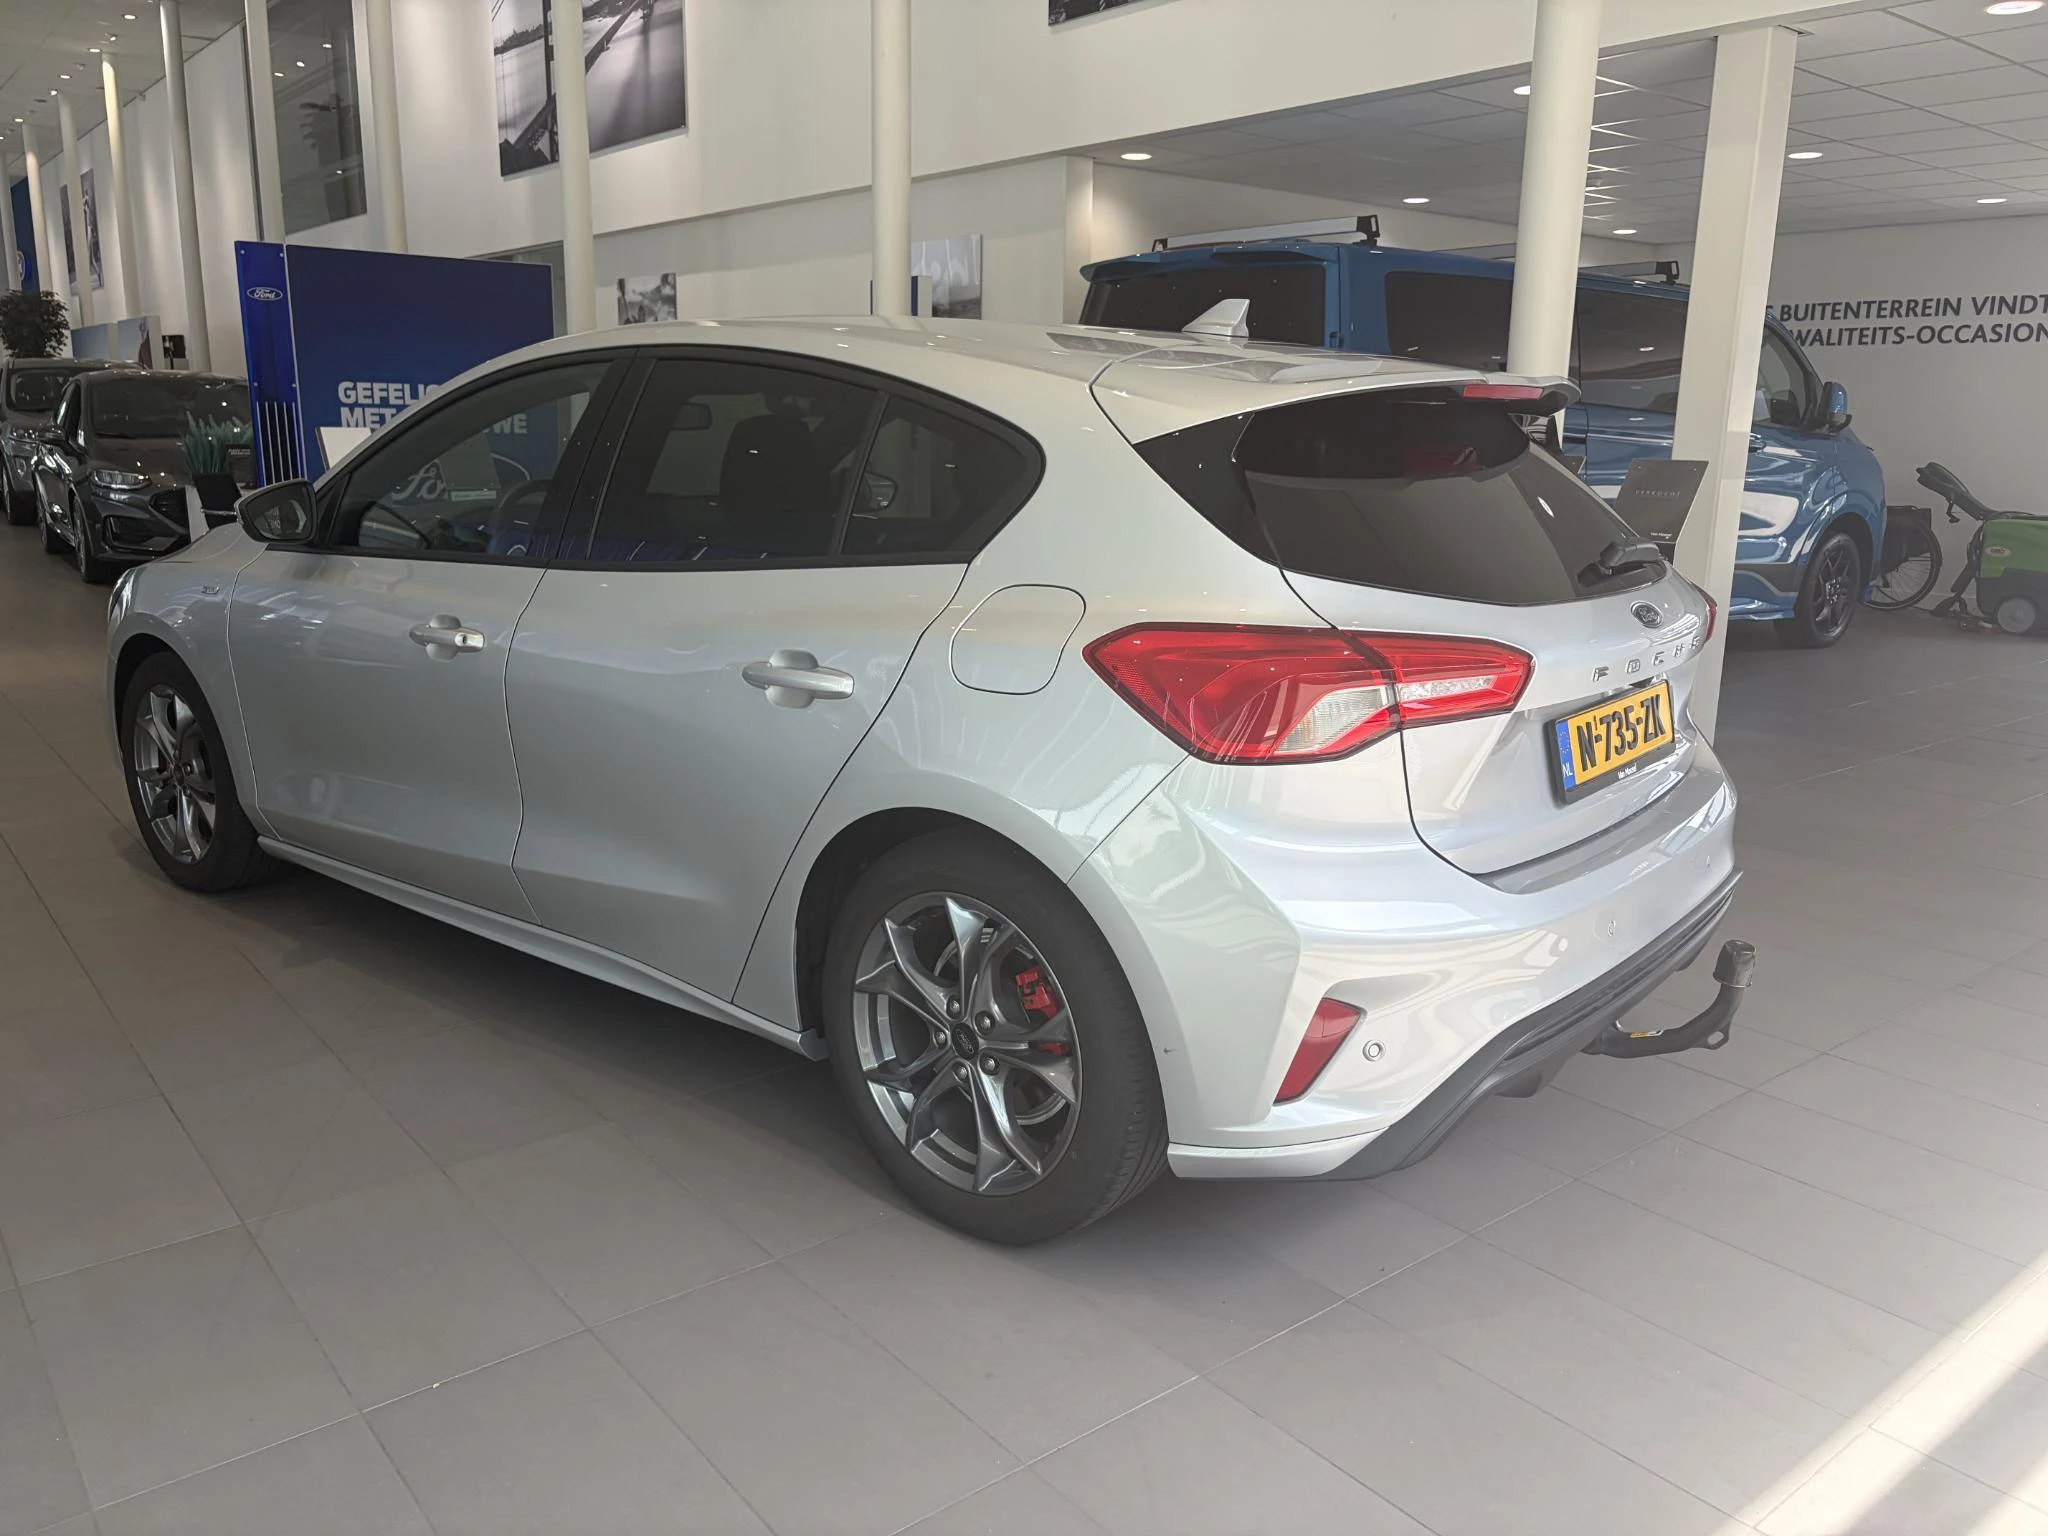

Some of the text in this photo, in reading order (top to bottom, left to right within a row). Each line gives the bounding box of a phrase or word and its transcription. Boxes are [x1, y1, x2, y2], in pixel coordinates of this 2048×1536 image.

[1780, 294, 2048, 321] BUITENTERREIN VINDT
[1789, 322, 2048, 347] WALITEITS-OCCASION
[340, 406, 397, 429] MET
[1576, 694, 1666, 772] N-735-ZK
[1562, 763, 1573, 777] NL
